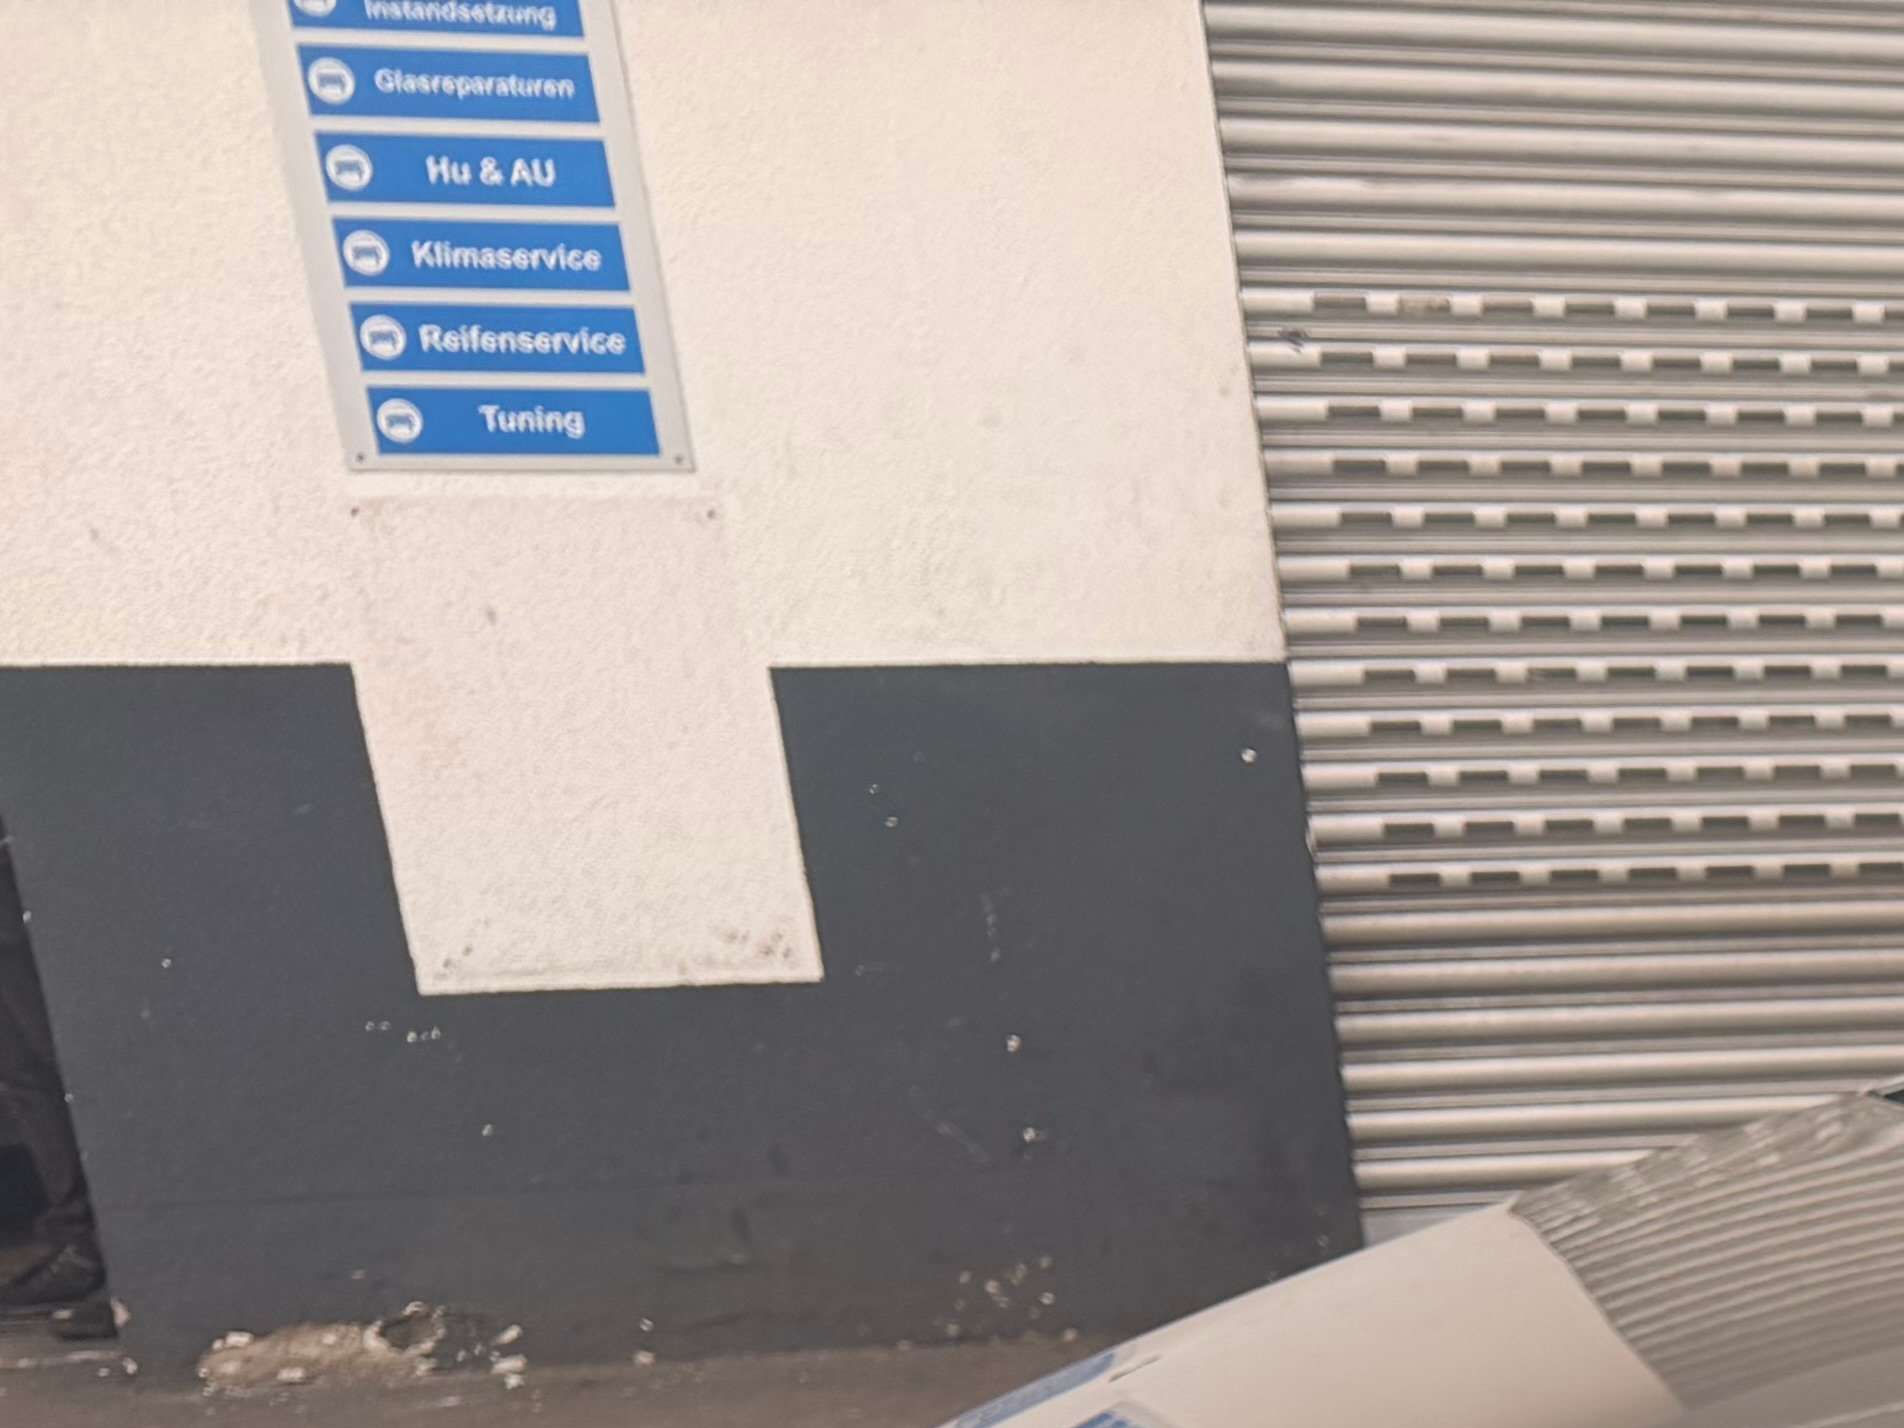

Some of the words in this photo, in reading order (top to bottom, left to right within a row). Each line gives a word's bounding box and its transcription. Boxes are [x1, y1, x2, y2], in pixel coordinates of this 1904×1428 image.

[365, 0, 557, 31] Instandsetzung
[374, 67, 576, 99] Glasreparaturen
[425, 154, 470, 187] Hu
[479, 156, 504, 186] &
[510, 158, 556, 188] AU
[411, 240, 602, 272] Klimaservice
[418, 323, 626, 356] Reifenservice
[477, 404, 586, 440] Tuning
